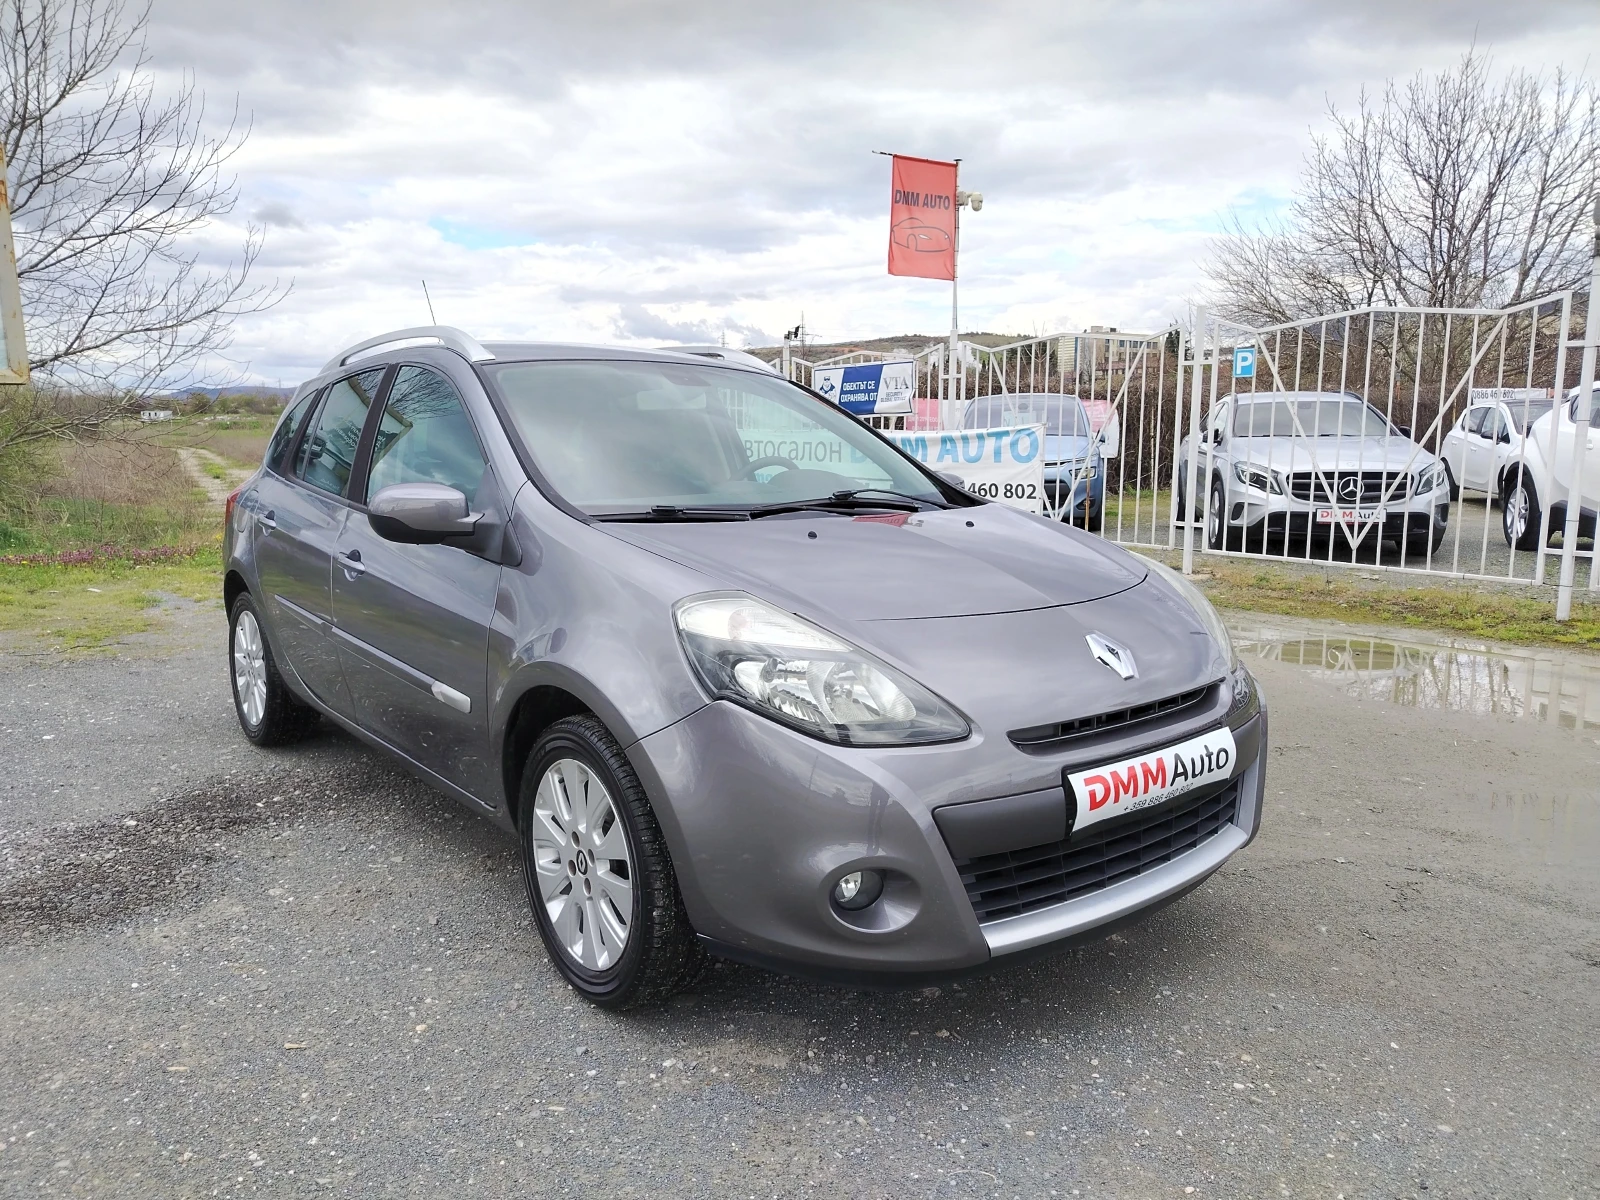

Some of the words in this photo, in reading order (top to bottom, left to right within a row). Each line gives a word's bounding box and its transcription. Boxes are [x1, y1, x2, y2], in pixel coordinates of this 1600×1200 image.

[894, 189, 919, 207] DMM
[922, 193, 951, 210] AUTO
[1236, 352, 1253, 374] P
[842, 382, 866, 391] ОБЕКТЪТ
[867, 381, 876, 390] СЕ
[883, 376, 909, 390] VTA
[840, 394, 869, 403] ОХРАНЯВА
[870, 392, 878, 401] ОТ
[1490, 390, 1502, 400] 46
[742, 439, 842, 463] втосалон
[936, 428, 1039, 464] AUTO
[968, 482, 999, 498] 460
[1003, 483, 1037, 499] 802
[1084, 756, 1167, 812] DMM
[1170, 744, 1229, 787] Auto
